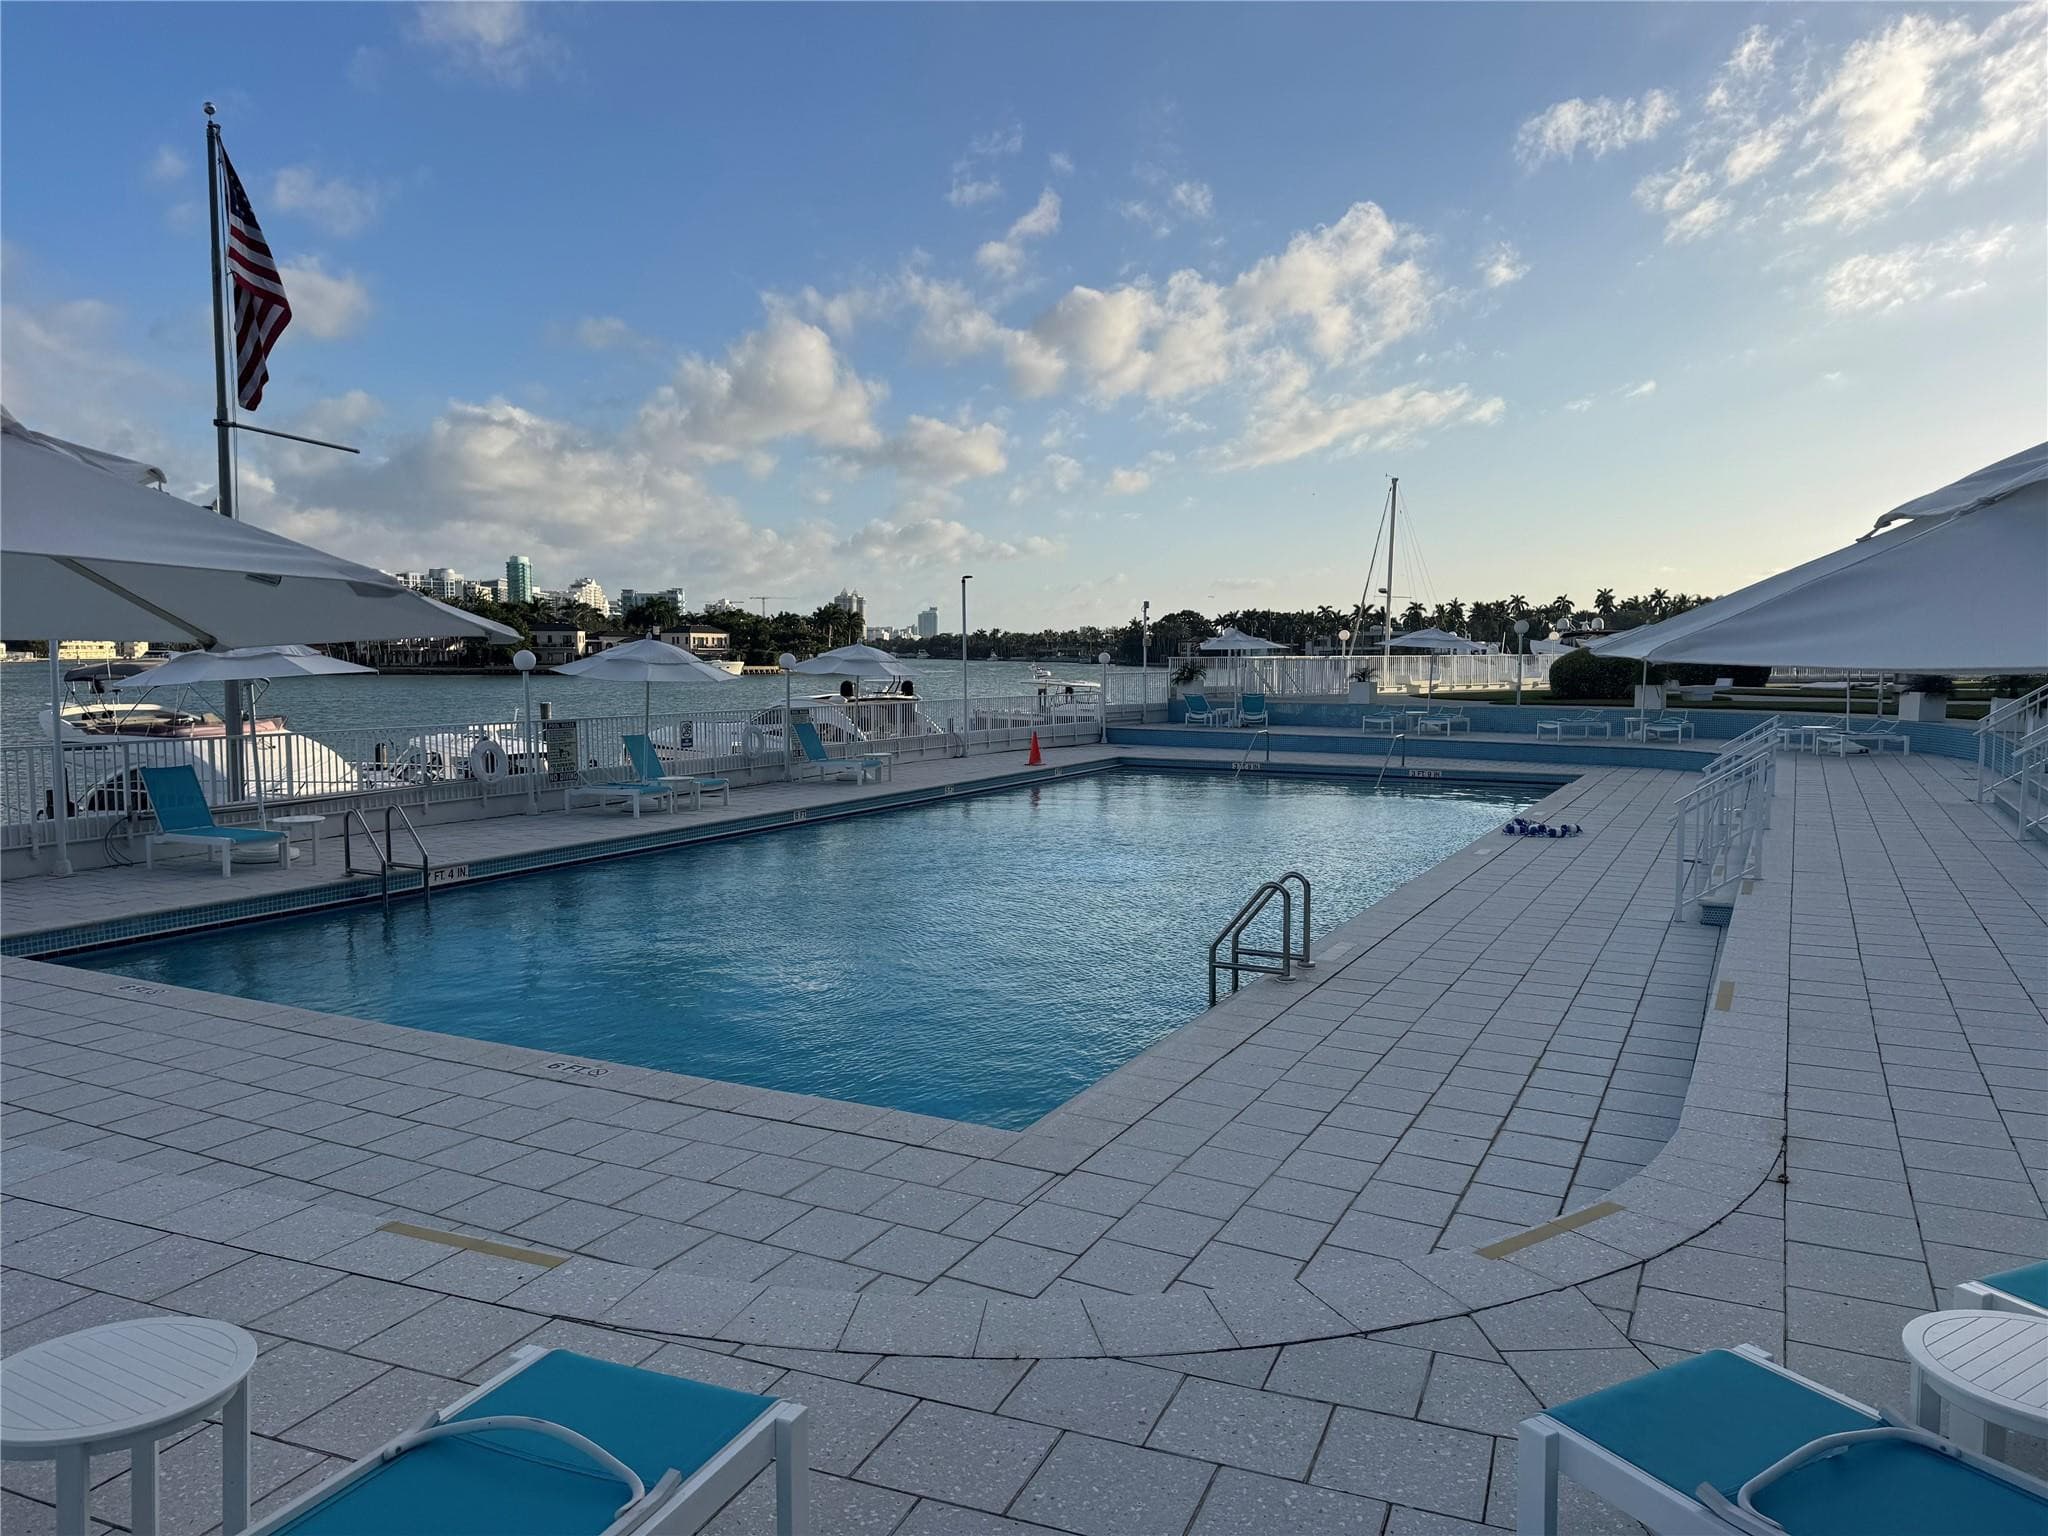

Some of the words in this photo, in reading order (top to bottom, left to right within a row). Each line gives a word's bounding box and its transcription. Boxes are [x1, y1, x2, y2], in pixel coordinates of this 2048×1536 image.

[549, 773, 559, 782] NO
[560, 771, 577, 781] DIVING
[448, 869, 454, 880] 4
